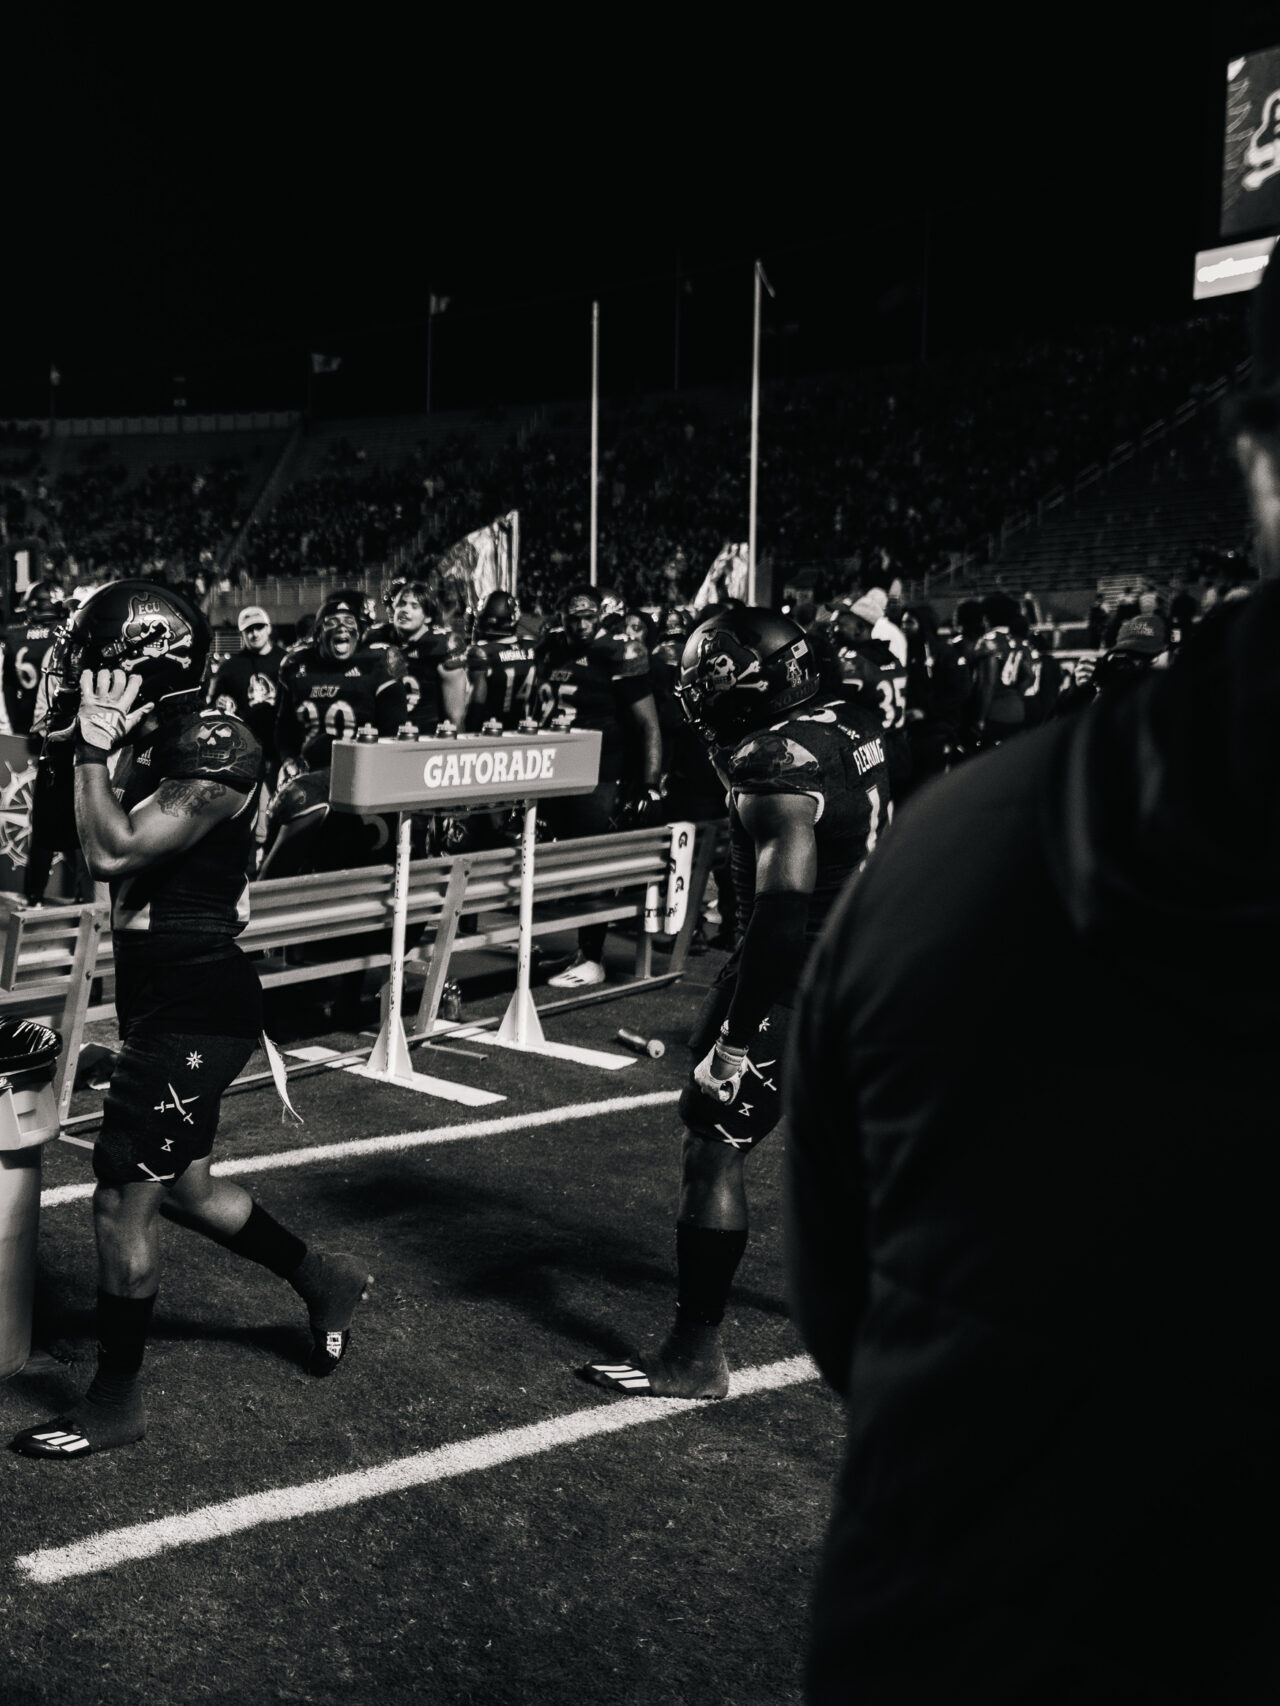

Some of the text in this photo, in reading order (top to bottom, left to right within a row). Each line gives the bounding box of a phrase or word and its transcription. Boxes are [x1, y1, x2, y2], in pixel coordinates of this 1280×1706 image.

[138, 602, 161, 615] ECU
[15, 646, 38, 690] 6
[875, 676, 908, 728] 35
[423, 749, 557, 788] GATORADE
[852, 738, 885, 776] FLEMING
